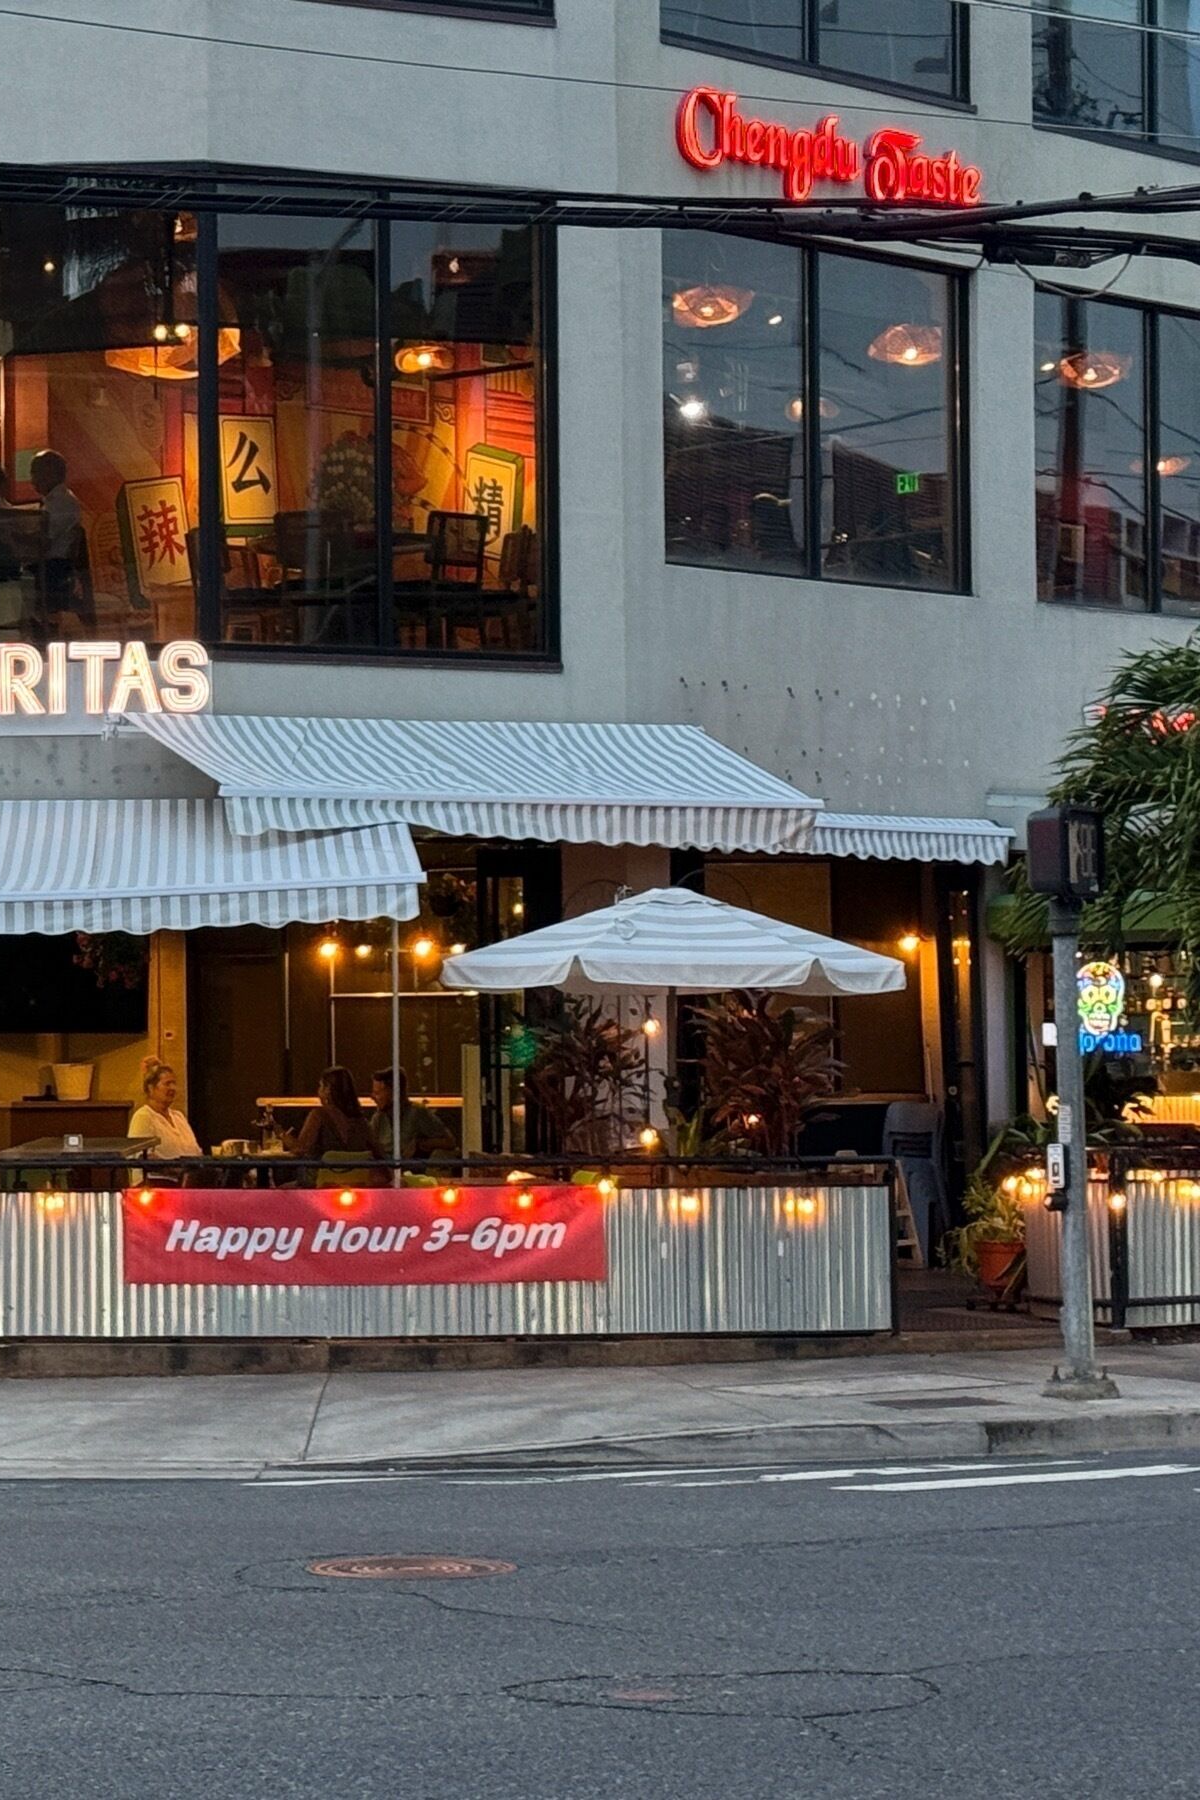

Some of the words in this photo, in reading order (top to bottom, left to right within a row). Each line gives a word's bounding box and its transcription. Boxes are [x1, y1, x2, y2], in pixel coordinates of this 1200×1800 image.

[676, 87, 860, 201] Chengdu
[864, 128, 983, 205] Taste
[225, 431, 271, 495] 么
[137, 500, 186, 570] 辣
[165, 1219, 302, 1260] Happy
[311, 1220, 420, 1253] Hour
[422, 1218, 567, 1258] 3-6pm
